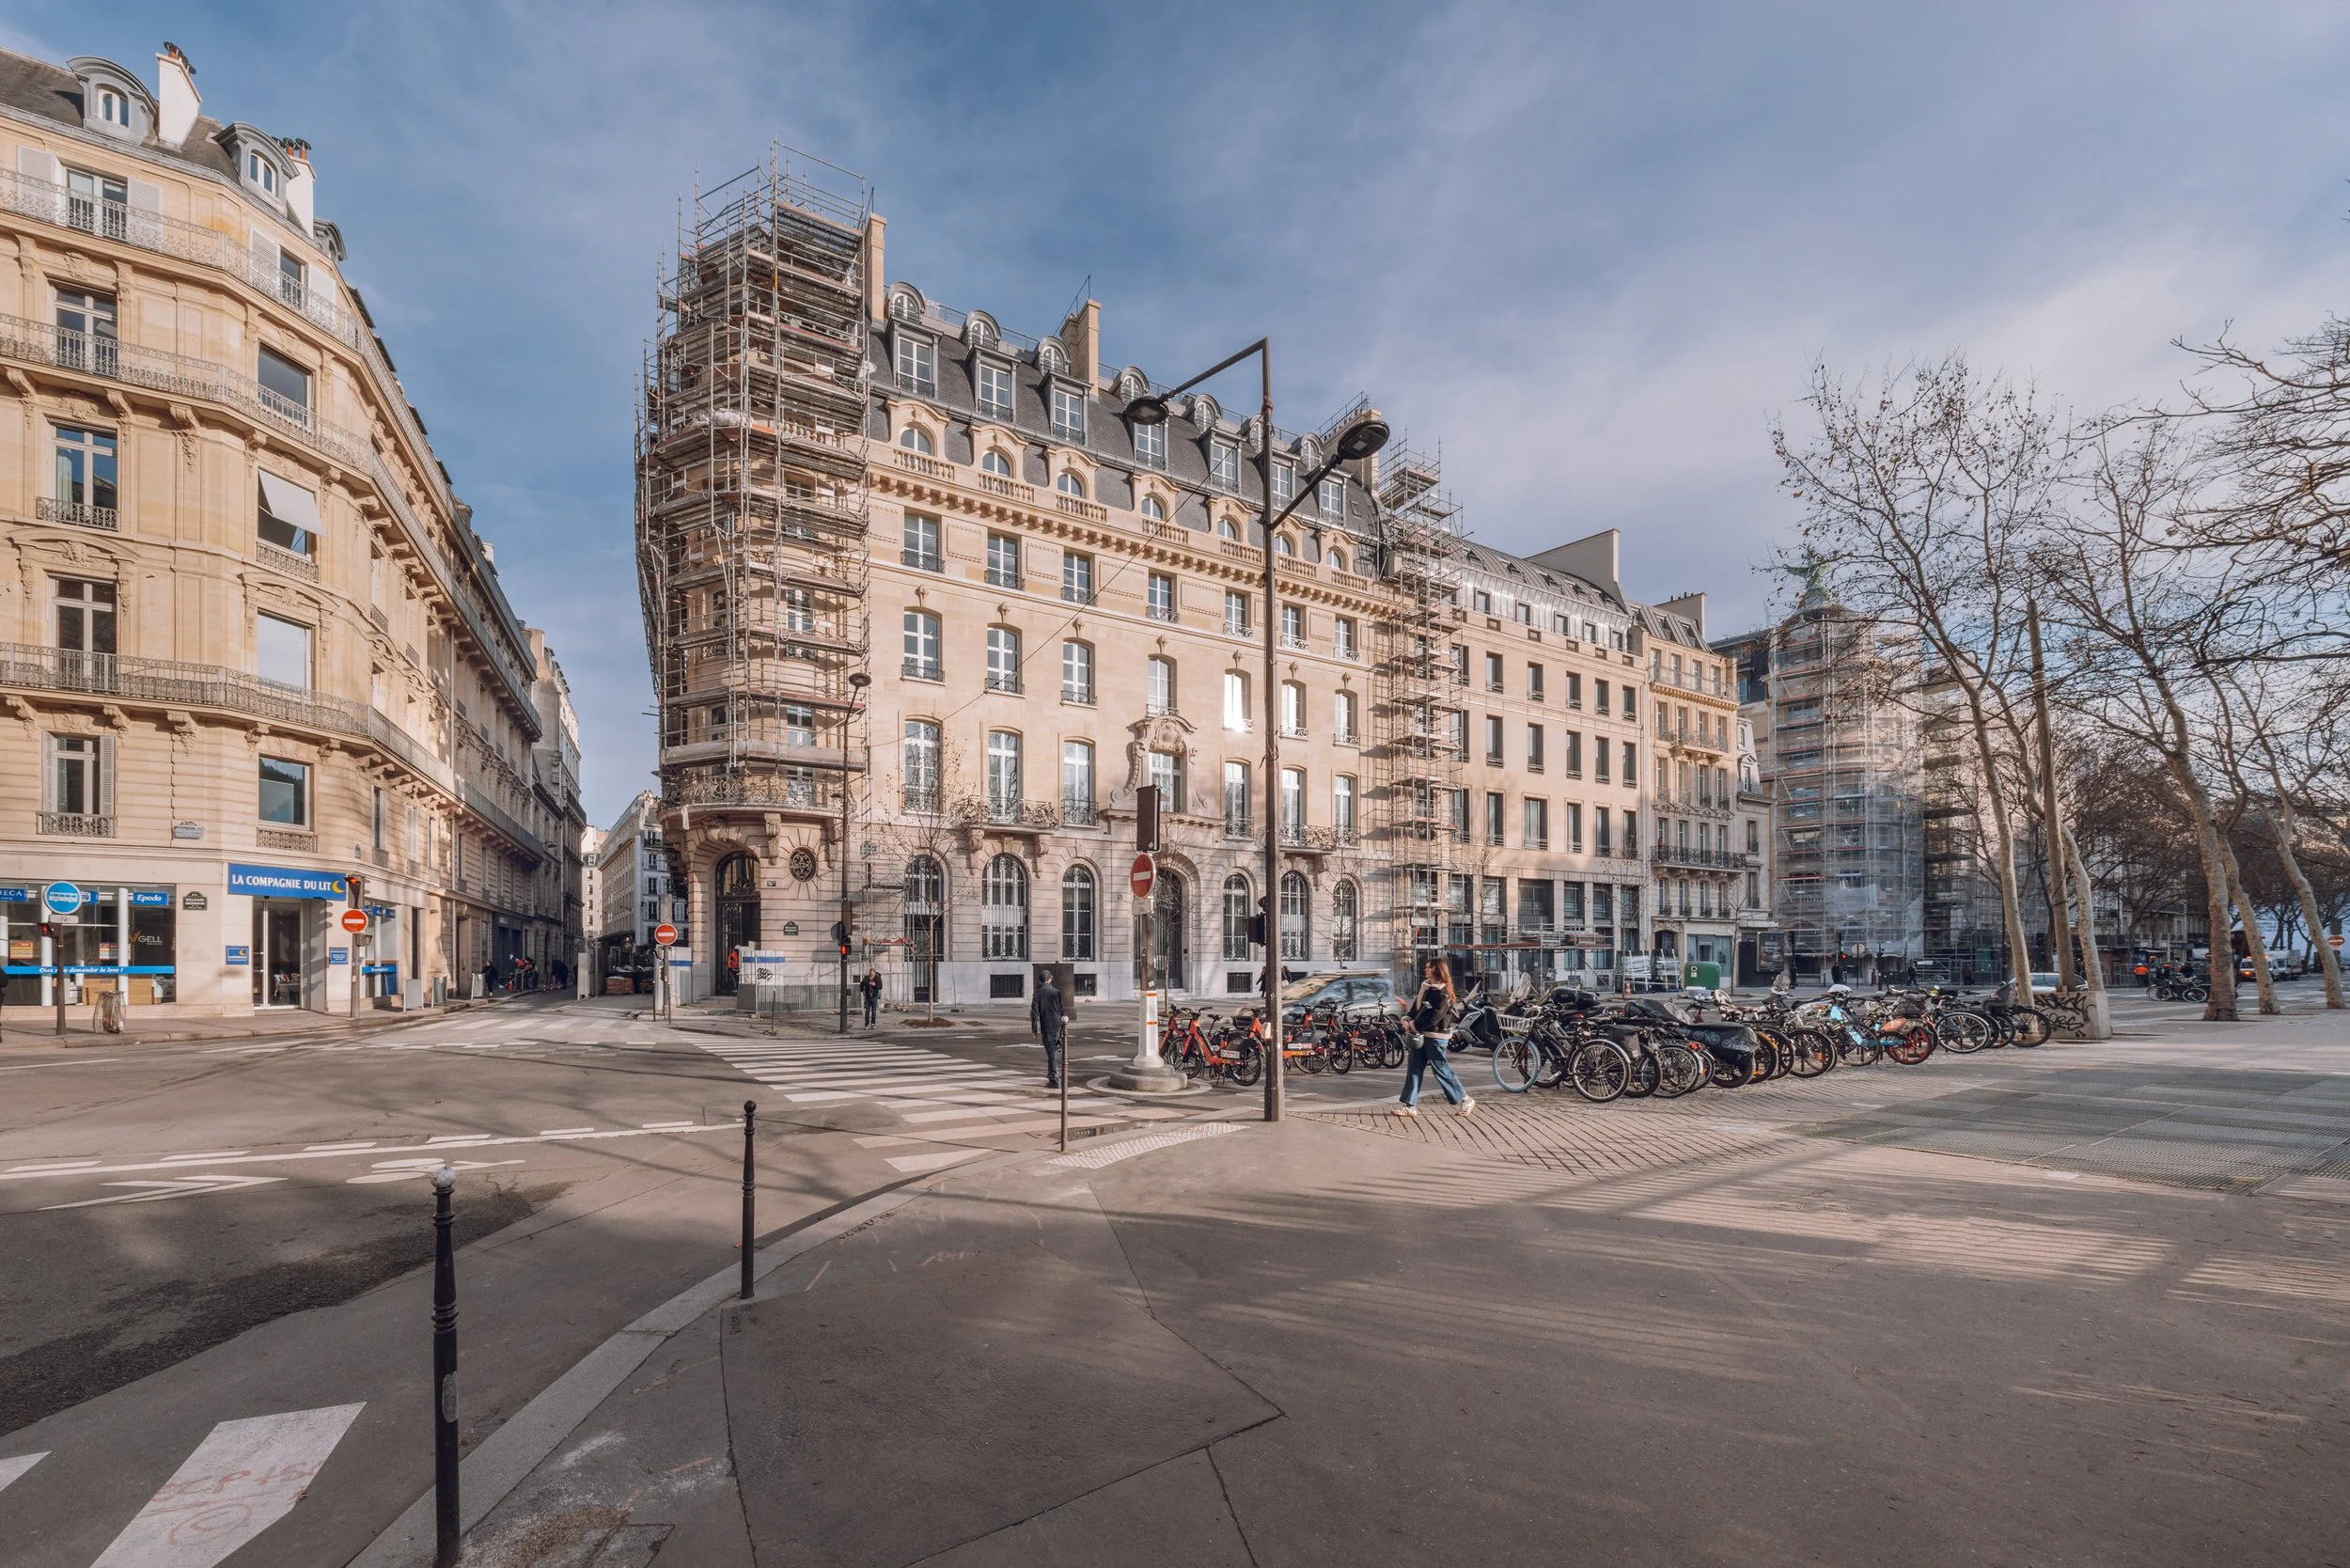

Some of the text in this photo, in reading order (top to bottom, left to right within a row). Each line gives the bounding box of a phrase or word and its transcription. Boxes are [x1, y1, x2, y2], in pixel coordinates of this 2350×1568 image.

[232, 874, 332, 891] LA COMPAGNIE DU LIT
[136, 894, 162, 902] Epeda
